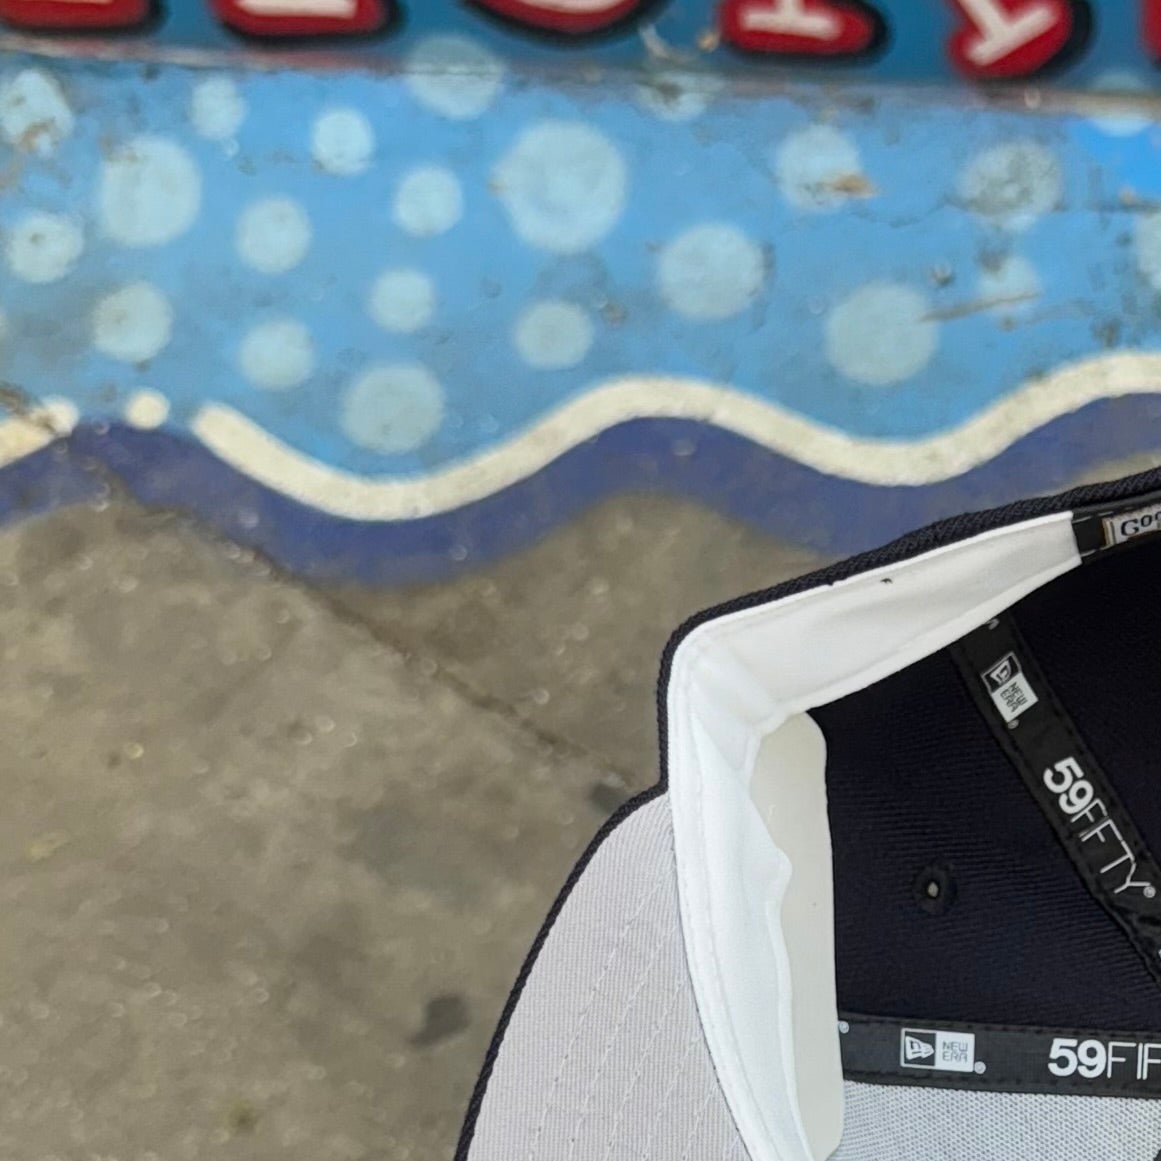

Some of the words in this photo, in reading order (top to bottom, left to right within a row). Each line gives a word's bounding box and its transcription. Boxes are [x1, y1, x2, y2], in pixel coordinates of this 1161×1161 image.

[999, 688, 1019, 713] ERA
[1007, 681, 1028, 706] NEW
[942, 1041, 968, 1051] NEW
[942, 1050, 968, 1063] ERA
